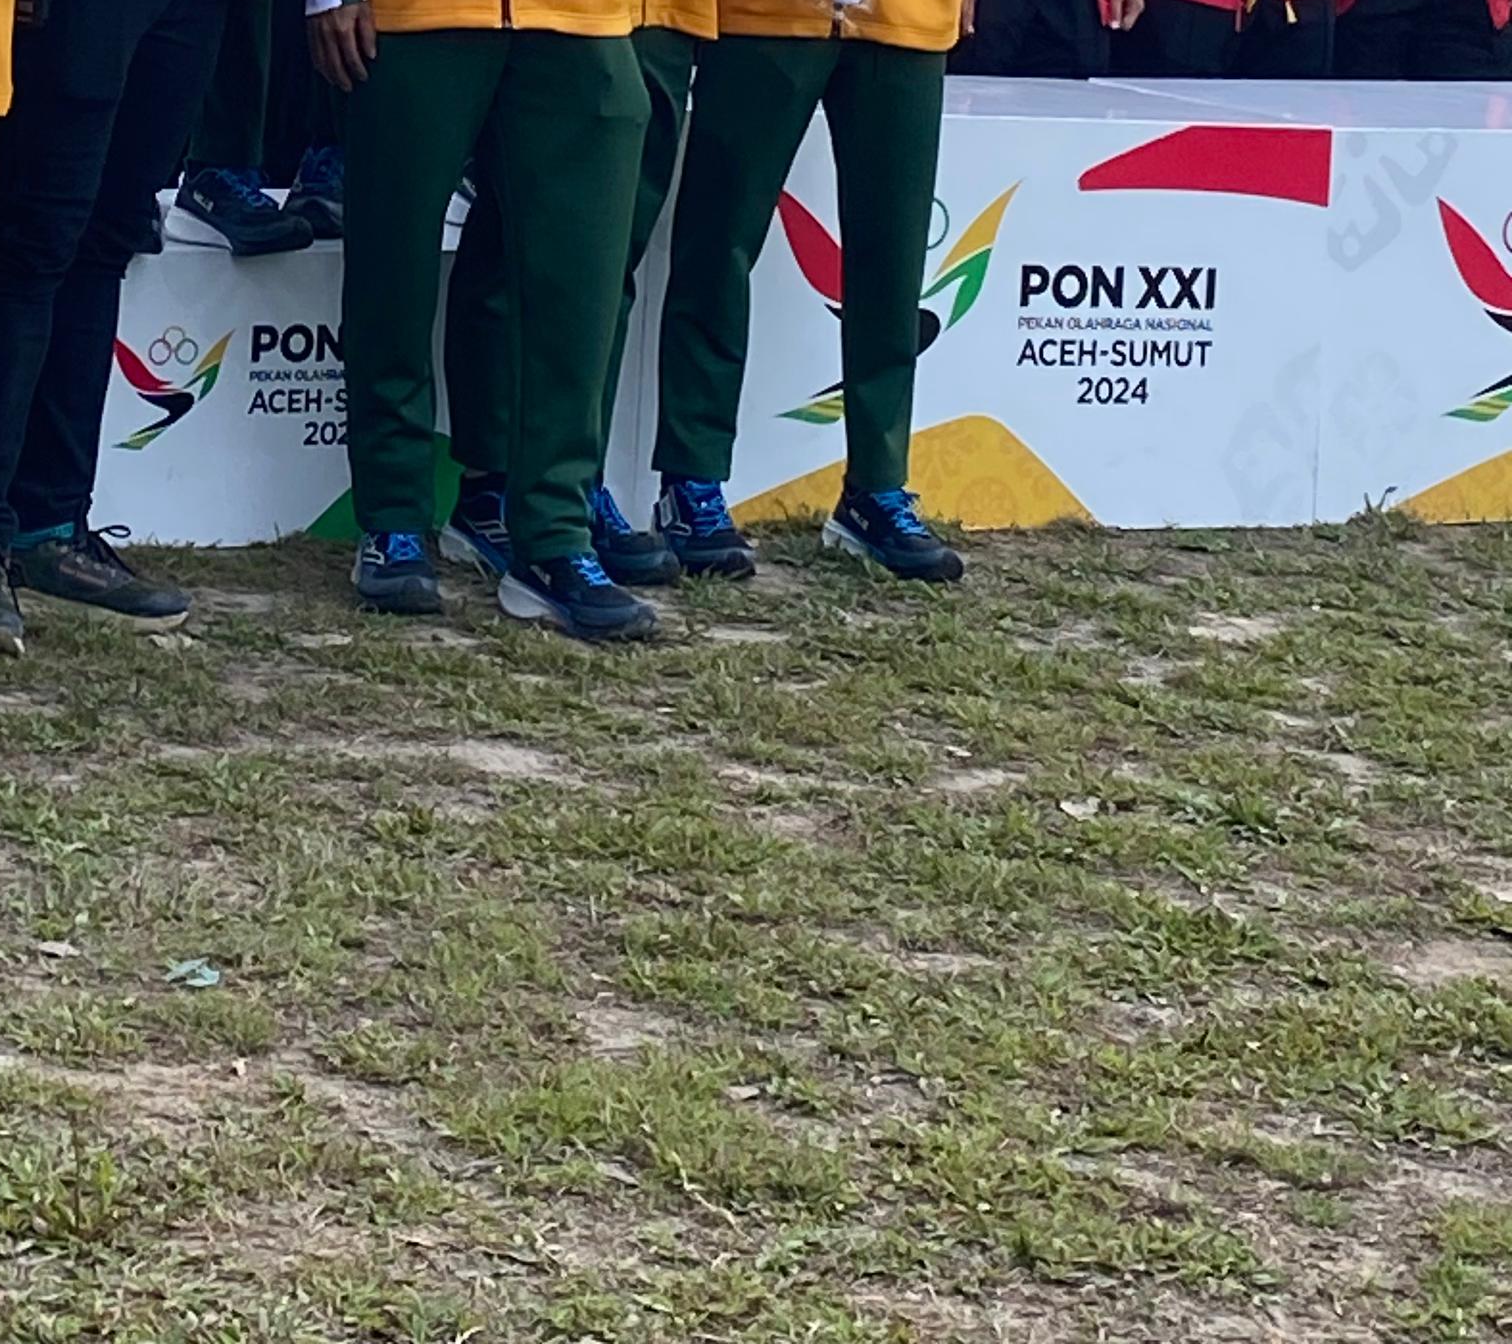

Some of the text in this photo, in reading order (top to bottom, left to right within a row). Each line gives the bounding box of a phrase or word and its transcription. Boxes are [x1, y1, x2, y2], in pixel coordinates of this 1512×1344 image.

[1019, 265, 1217, 310] PON XXI
[1018, 316, 1213, 332] PEKAN OLAHRAGA NASIONAL
[1016, 338, 1213, 367] ACEH-SUMUT
[247, 388, 348, 414] ACEH-S
[1077, 377, 1149, 405] 2024
[303, 421, 348, 445] 202
